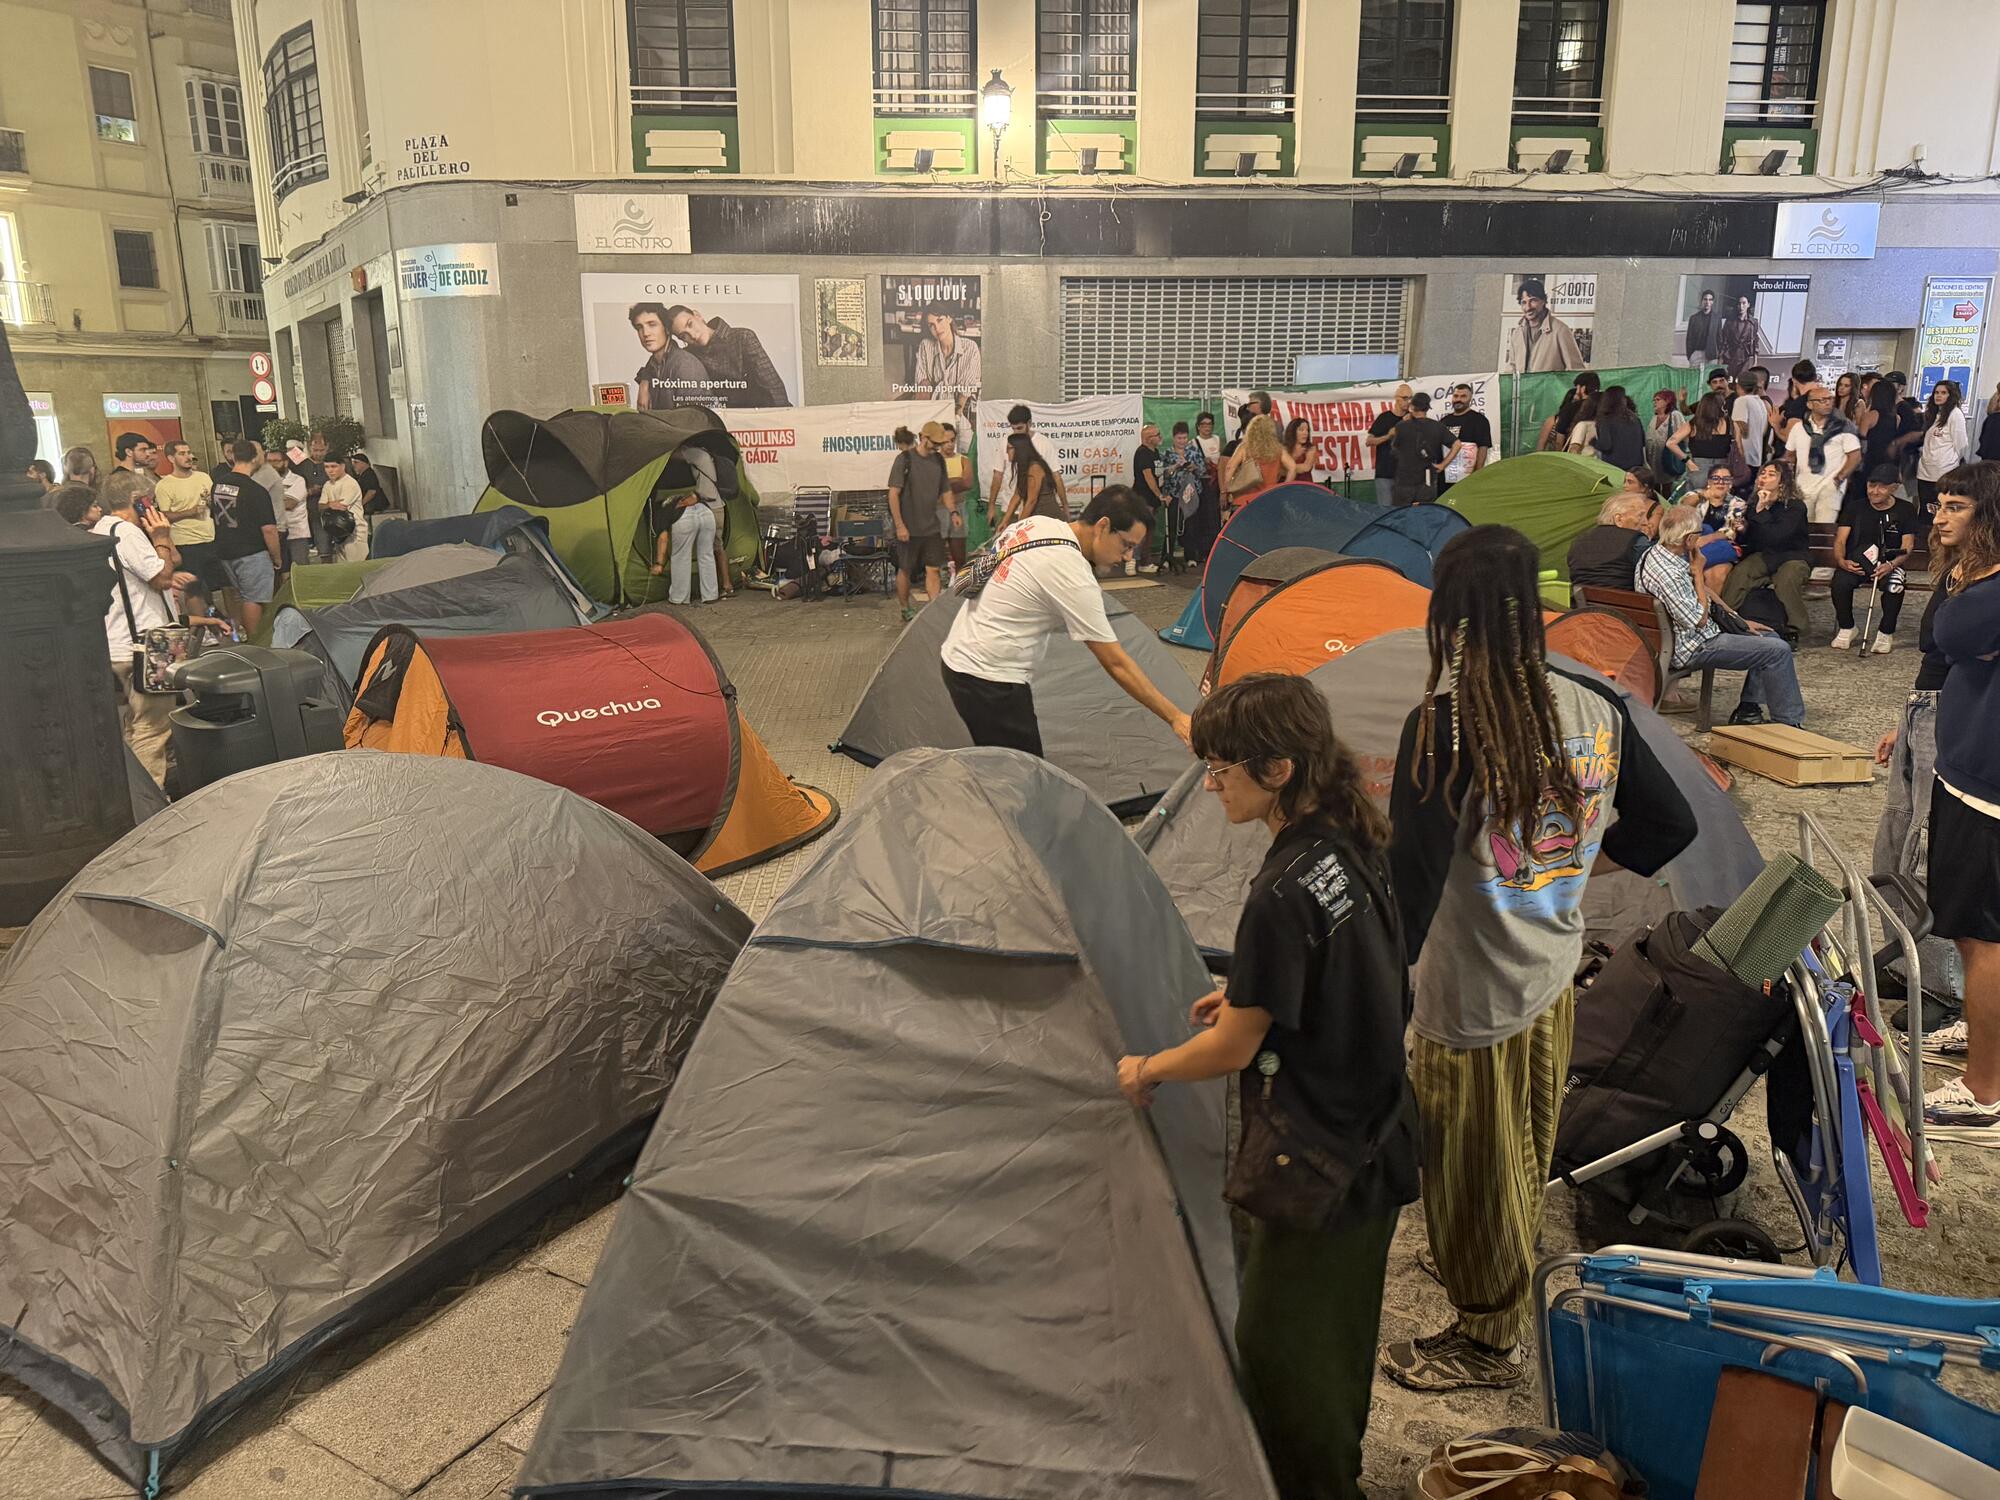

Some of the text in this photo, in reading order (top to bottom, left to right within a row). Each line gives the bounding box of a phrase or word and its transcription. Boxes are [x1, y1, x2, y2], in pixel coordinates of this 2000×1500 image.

[405, 134, 448, 151] PLAZA
[413, 150, 438, 164] DEL
[397, 161, 470, 180] PALILLERO
[595, 236, 672, 248] EL CENTRO
[1791, 243, 1860, 254] EL CENTRO
[401, 271, 428, 289] MUJER
[439, 269, 489, 287] DE CADIZ
[644, 284, 742, 295] CORTEFIEL
[1567, 282, 1595, 297] OOTO
[1753, 281, 1808, 290] Pedro del Hierro
[1926, 326, 1978, 335] DESTROZAMOS
[1928, 336, 1973, 346] LOS PRECIOS
[652, 378, 747, 390] Próxima apertura
[892, 383, 978, 394] Próxima apertura
[1059, 420, 1091, 428] ALQUILER
[1101, 417, 1140, 426] TEMPORADA
[1287, 400, 1376, 433] VIVIENDA
[731, 430, 794, 448] NQUILINAS
[1095, 429, 1135, 438] MORATORIA
[745, 447, 778, 464] CÁDIZ
[1058, 447, 1122, 459] SIN CASA,
[1082, 463, 1124, 475] GENTE
[536, 698, 661, 727] Quechua
